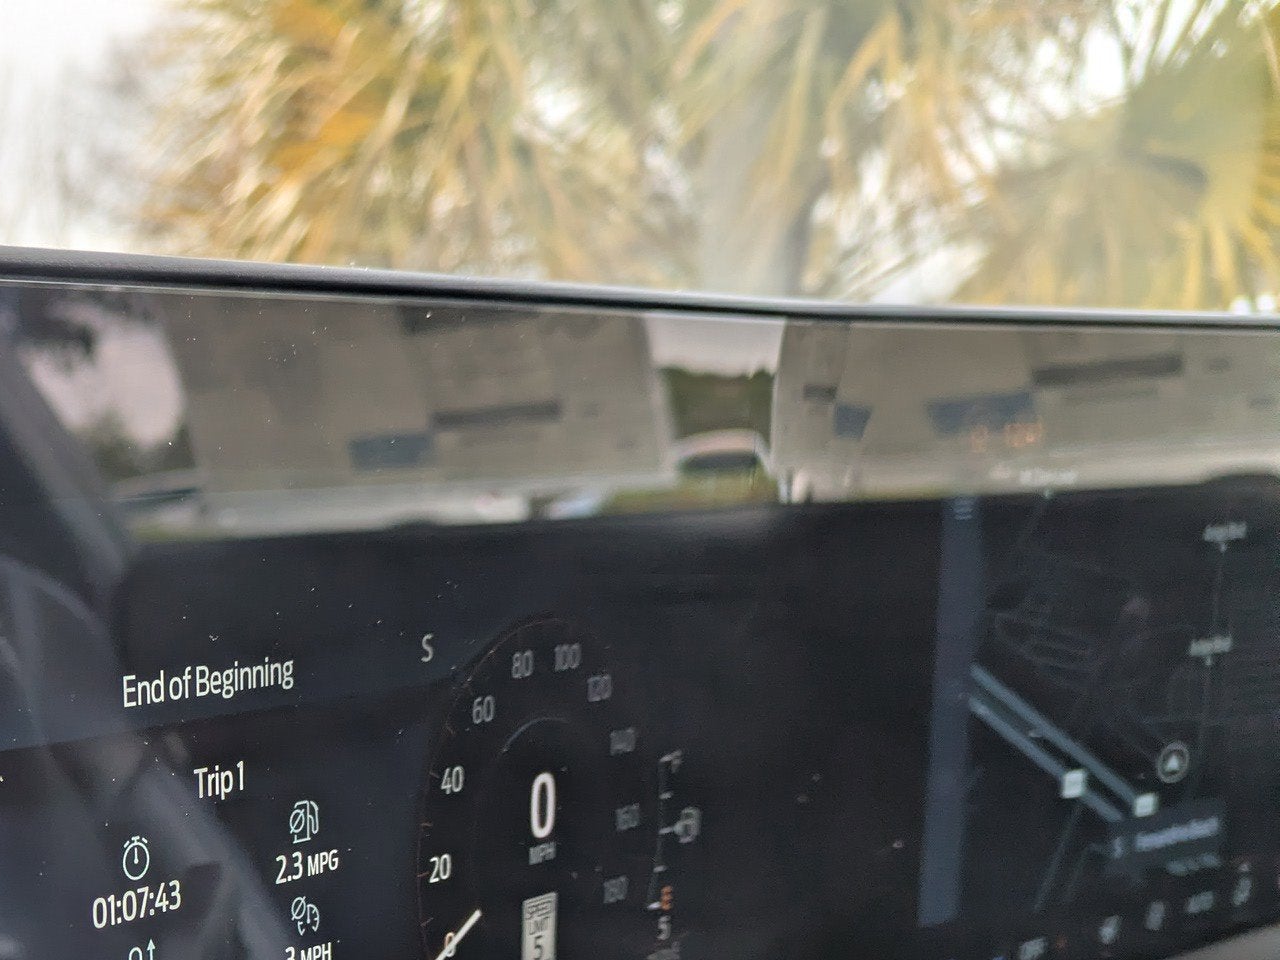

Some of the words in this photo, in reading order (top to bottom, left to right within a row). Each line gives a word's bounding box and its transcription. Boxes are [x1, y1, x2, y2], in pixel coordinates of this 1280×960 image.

[422, 634, 434, 662] S
[511, 650, 534, 679] 80
[123, 670, 164, 707] End
[170, 667, 193, 700] of
[196, 656, 294, 700] Beginning
[472, 695, 496, 724] 60
[194, 765, 231, 801] Trip
[236, 761, 244, 789] 1
[440, 766, 464, 795] 40
[529, 772, 556, 840] 0
[275, 852, 303, 885] 2.3
[307, 851, 339, 879] MPG
[429, 855, 451, 884] 20
[91, 880, 182, 930] 01:07:43
